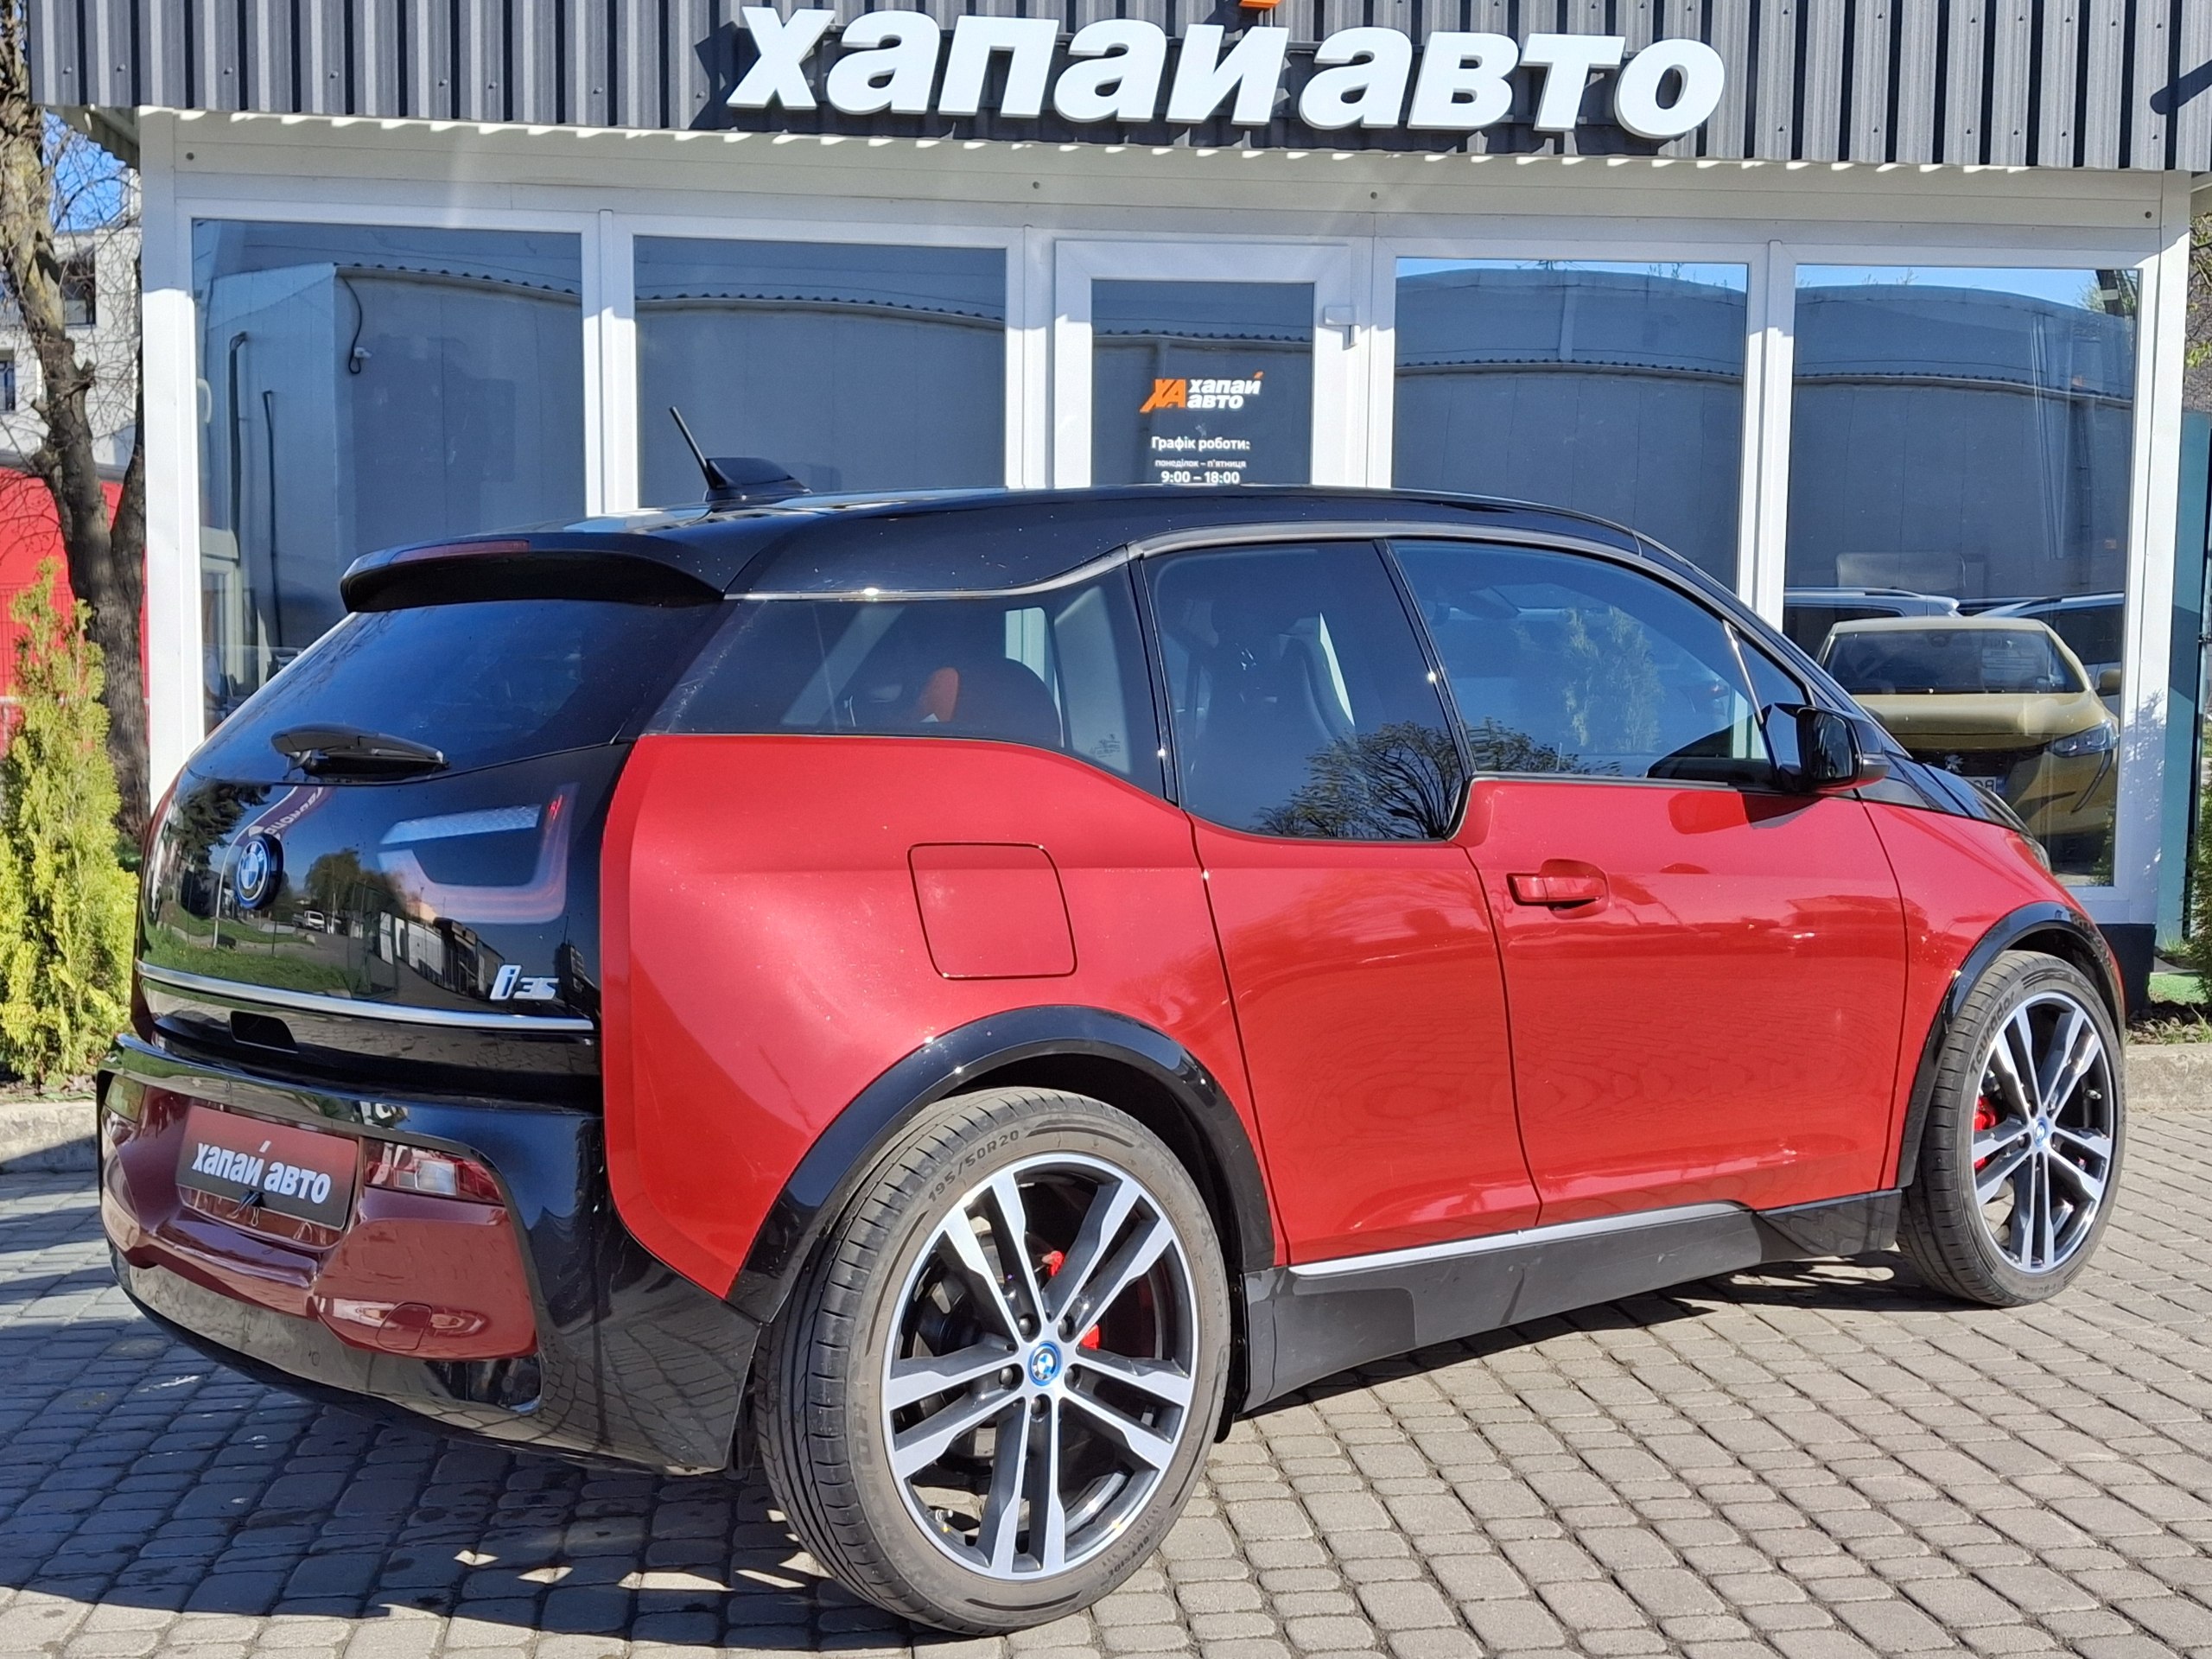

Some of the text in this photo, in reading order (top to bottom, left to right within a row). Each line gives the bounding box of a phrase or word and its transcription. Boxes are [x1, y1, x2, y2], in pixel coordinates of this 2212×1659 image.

[1299, 25, 1726, 139] авто
[1188, 371, 1264, 395] хапай
[1187, 394, 1244, 410] авто
[1151, 435, 1251, 452] Графік роботи:
[1154, 458, 1199, 468] понеділок
[1160, 470, 1191, 483] 9:00
[1204, 471, 1241, 484] 18:00
[1970, 991, 2015, 1074] Tourador
[191, 1139, 333, 1205] хапай авто
[928, 1129, 1019, 1202] 195/50R20
